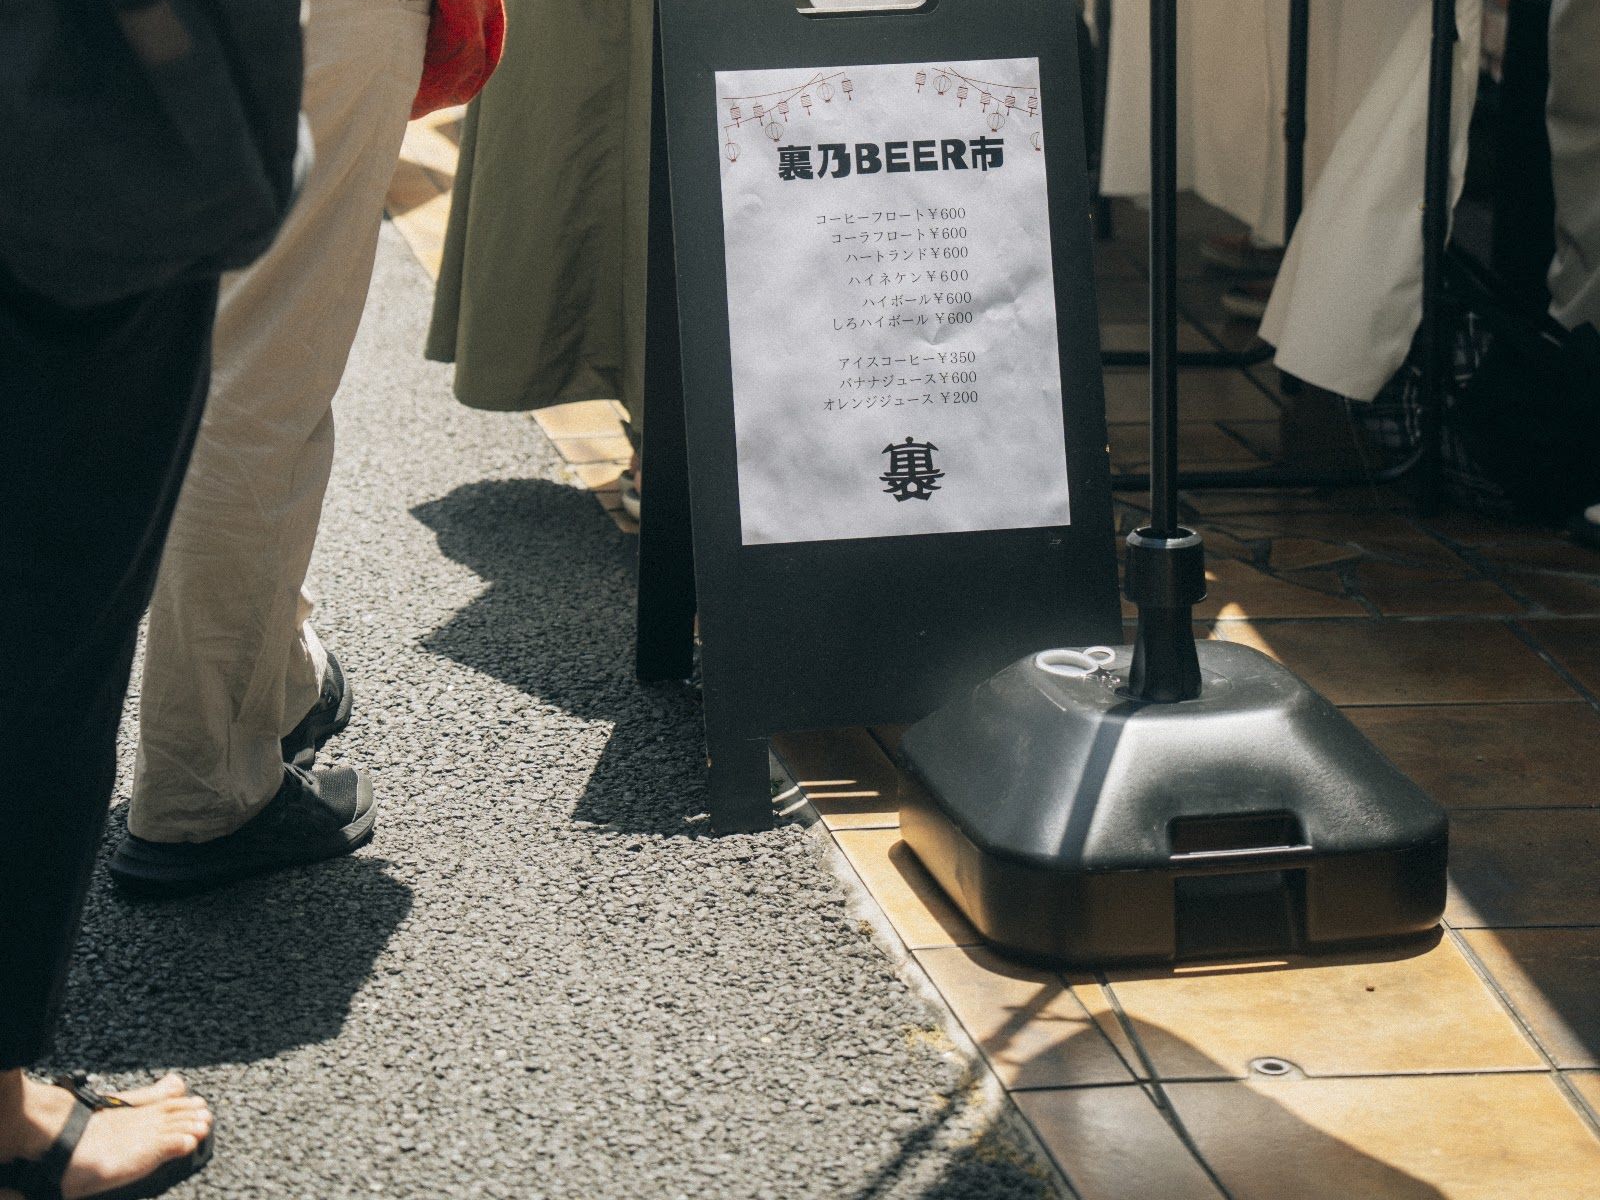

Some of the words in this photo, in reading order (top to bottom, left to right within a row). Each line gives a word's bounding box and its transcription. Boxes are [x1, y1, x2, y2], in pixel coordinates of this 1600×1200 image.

[776, 135, 1004, 181] 裏乃BEER市
[879, 436, 946, 502] 裏
